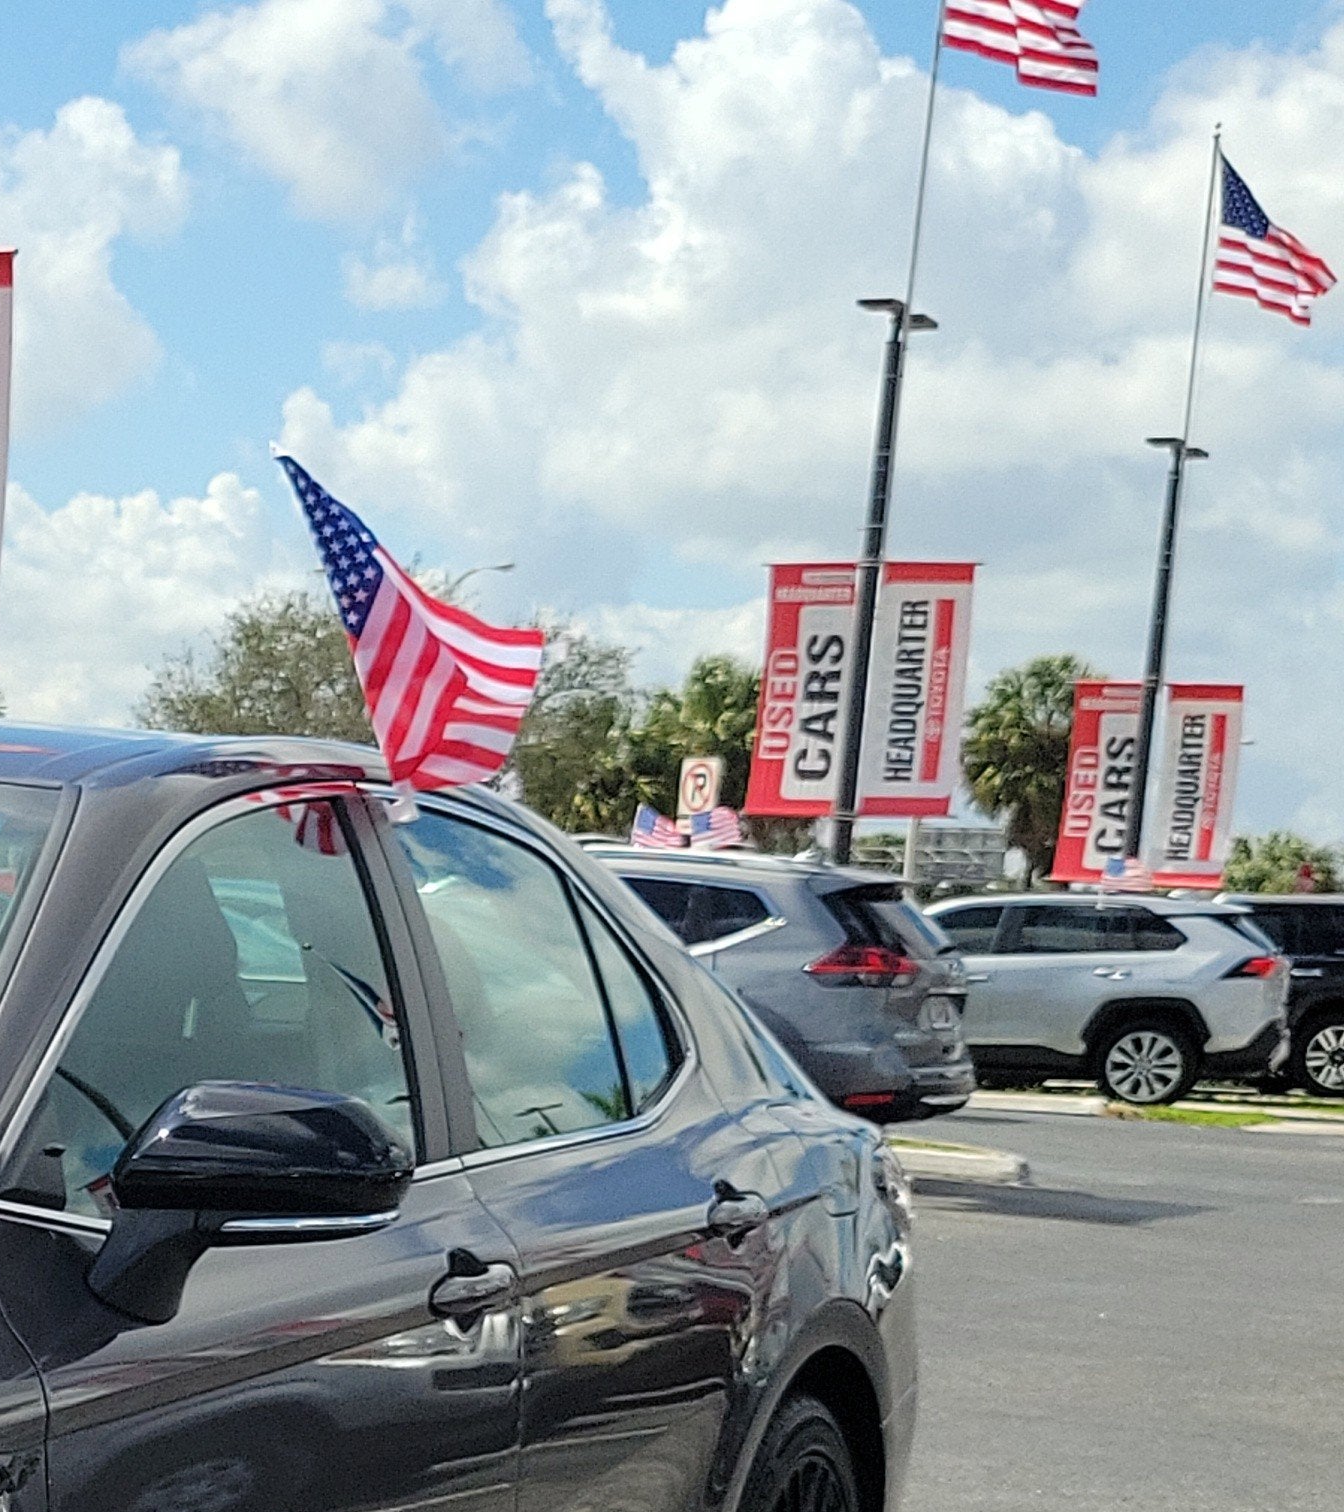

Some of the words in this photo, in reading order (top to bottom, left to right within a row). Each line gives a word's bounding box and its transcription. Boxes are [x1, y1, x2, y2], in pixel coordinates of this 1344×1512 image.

[762, 650, 800, 753] USED
[794, 634, 845, 782] CARS
[883, 600, 930, 783] HEADQUARTER
[1068, 750, 1100, 833] USED
[1095, 736, 1135, 854] CARS
[1166, 713, 1206, 862] HEADQUARTER
